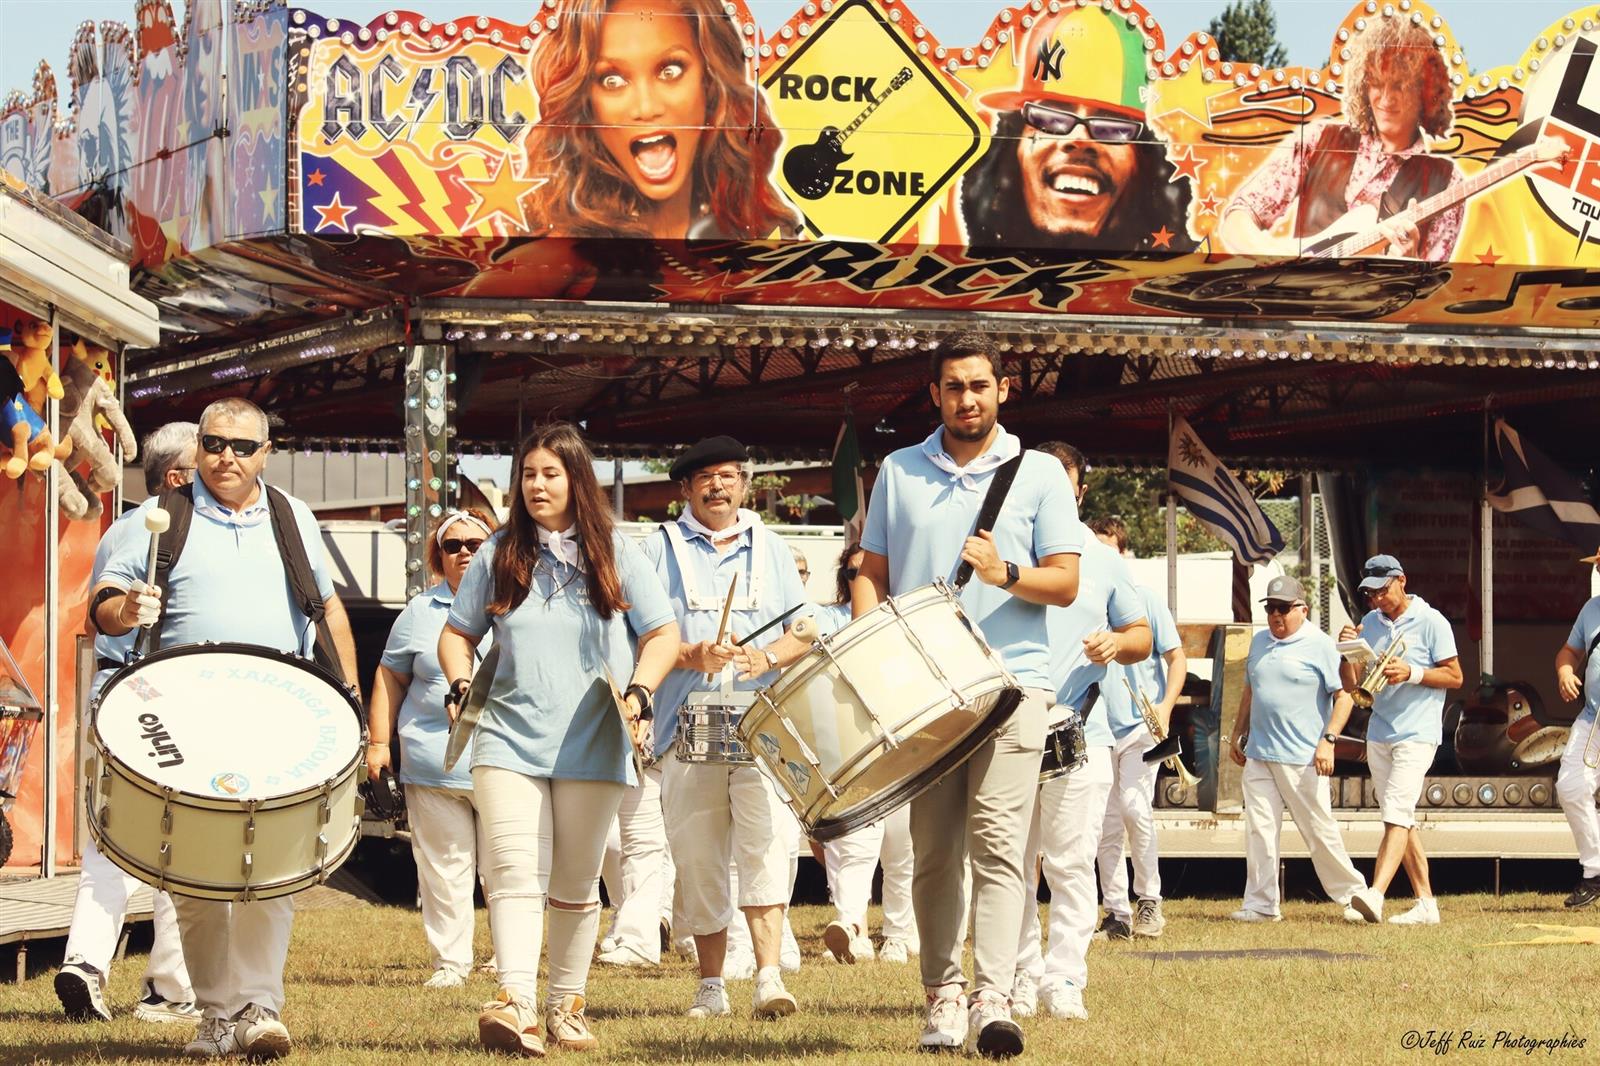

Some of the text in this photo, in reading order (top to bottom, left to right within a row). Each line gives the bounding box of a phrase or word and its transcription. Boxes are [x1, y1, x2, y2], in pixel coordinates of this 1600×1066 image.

[779, 74, 878, 102] ROCK
[835, 169, 927, 197] ZONE
[227, 668, 331, 719] XARANGA
[138, 713, 185, 768] Linko
